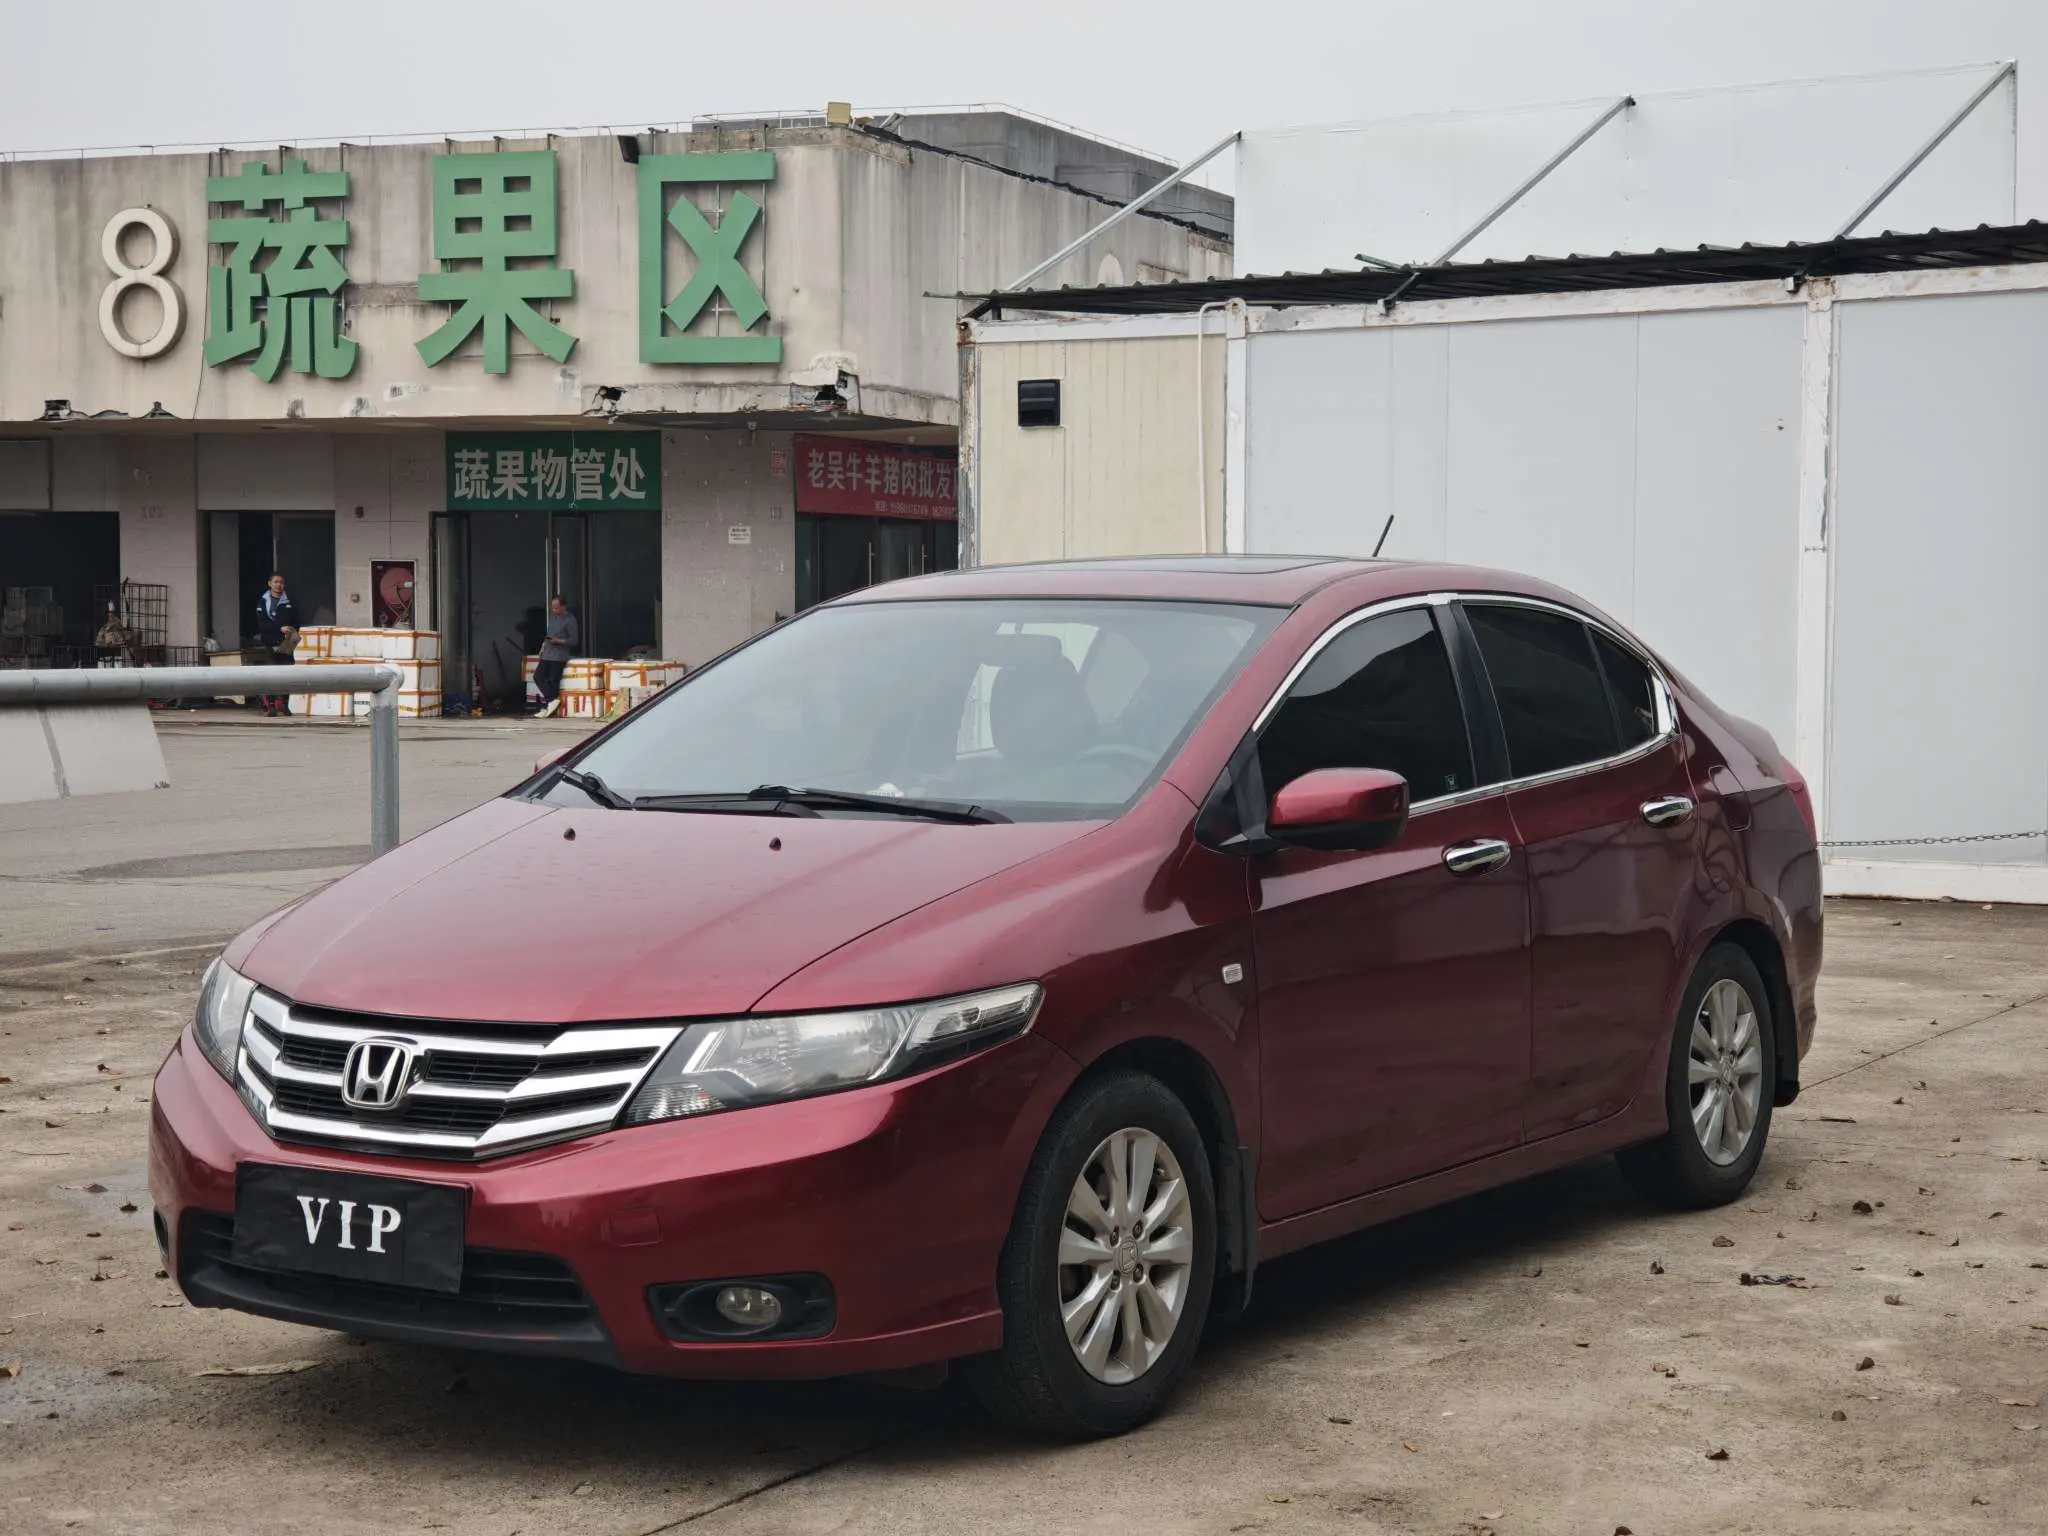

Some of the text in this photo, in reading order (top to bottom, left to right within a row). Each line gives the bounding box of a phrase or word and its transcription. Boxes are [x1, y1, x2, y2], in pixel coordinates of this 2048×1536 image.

[203, 150, 783, 384] 蔬果区
[453, 447, 647, 500] 蔬果物管处
[807, 449, 959, 500] 老吴牛羊猪肉批发
[296, 1195, 401, 1253] VIP
